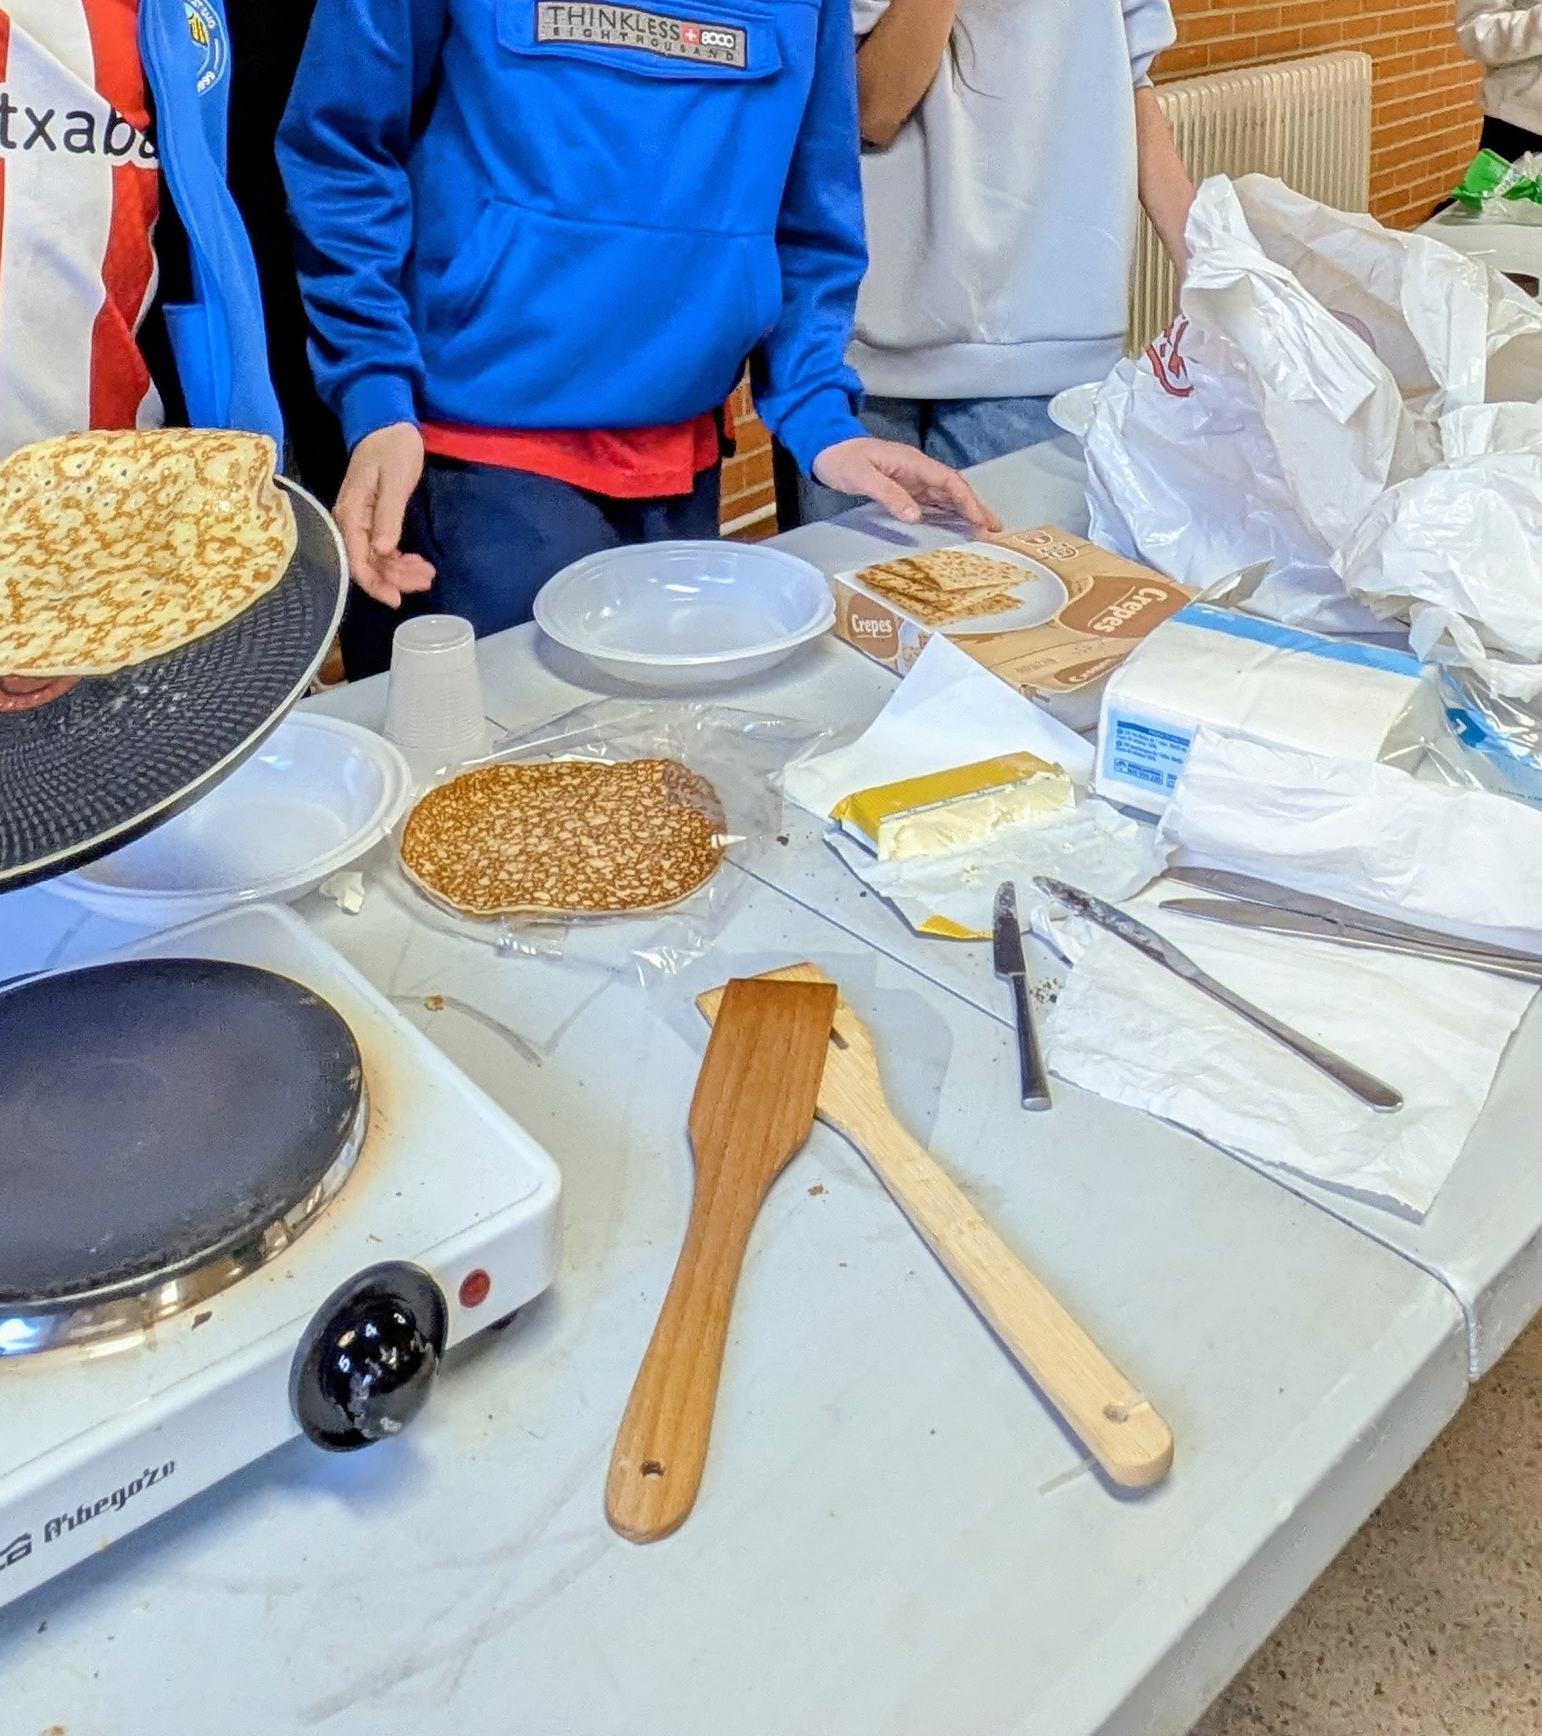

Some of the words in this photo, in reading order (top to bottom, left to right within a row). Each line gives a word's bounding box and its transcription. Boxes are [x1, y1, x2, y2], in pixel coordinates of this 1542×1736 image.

[547, 5, 681, 41] THINKLESS
[851, 613, 893, 639] Crepes
[1093, 586, 1169, 633] Crepes
